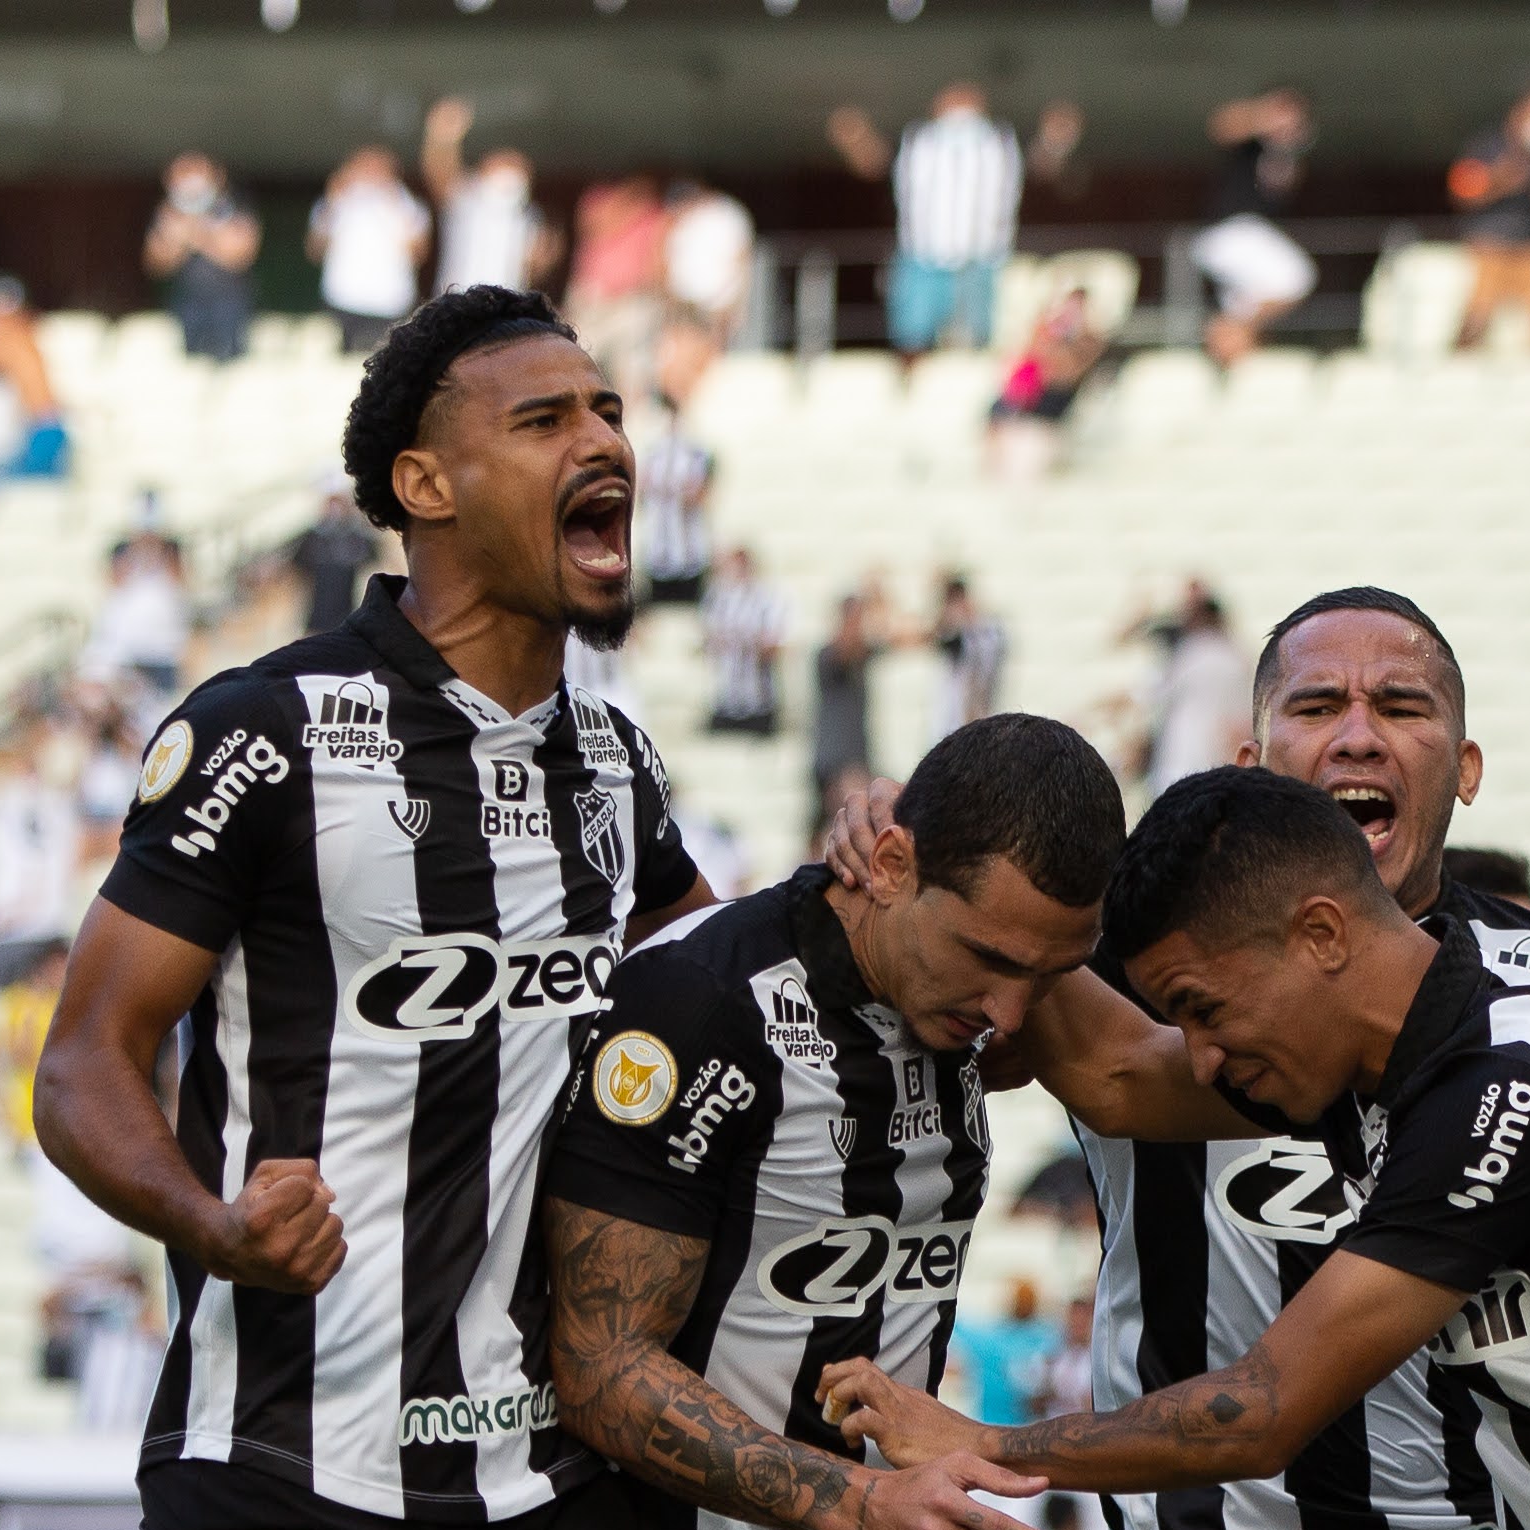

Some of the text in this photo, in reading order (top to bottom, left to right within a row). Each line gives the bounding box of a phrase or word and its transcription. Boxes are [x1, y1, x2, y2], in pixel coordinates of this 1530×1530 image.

[306, 727, 379, 744] Freitas
[328, 740, 400, 762] varejo
[200, 729, 247, 776] VOZÃO
[589, 744, 627, 766] varejo
[185, 735, 289, 833] bmg
[483, 806, 550, 837] Bitci
[767, 1024, 817, 1042] Freitas
[784, 1040, 834, 1061] varejo
[679, 1059, 722, 1109] VOZÃO
[889, 1105, 941, 1144] Bitci
[1471, 1084, 1501, 1137] VOZÃO
